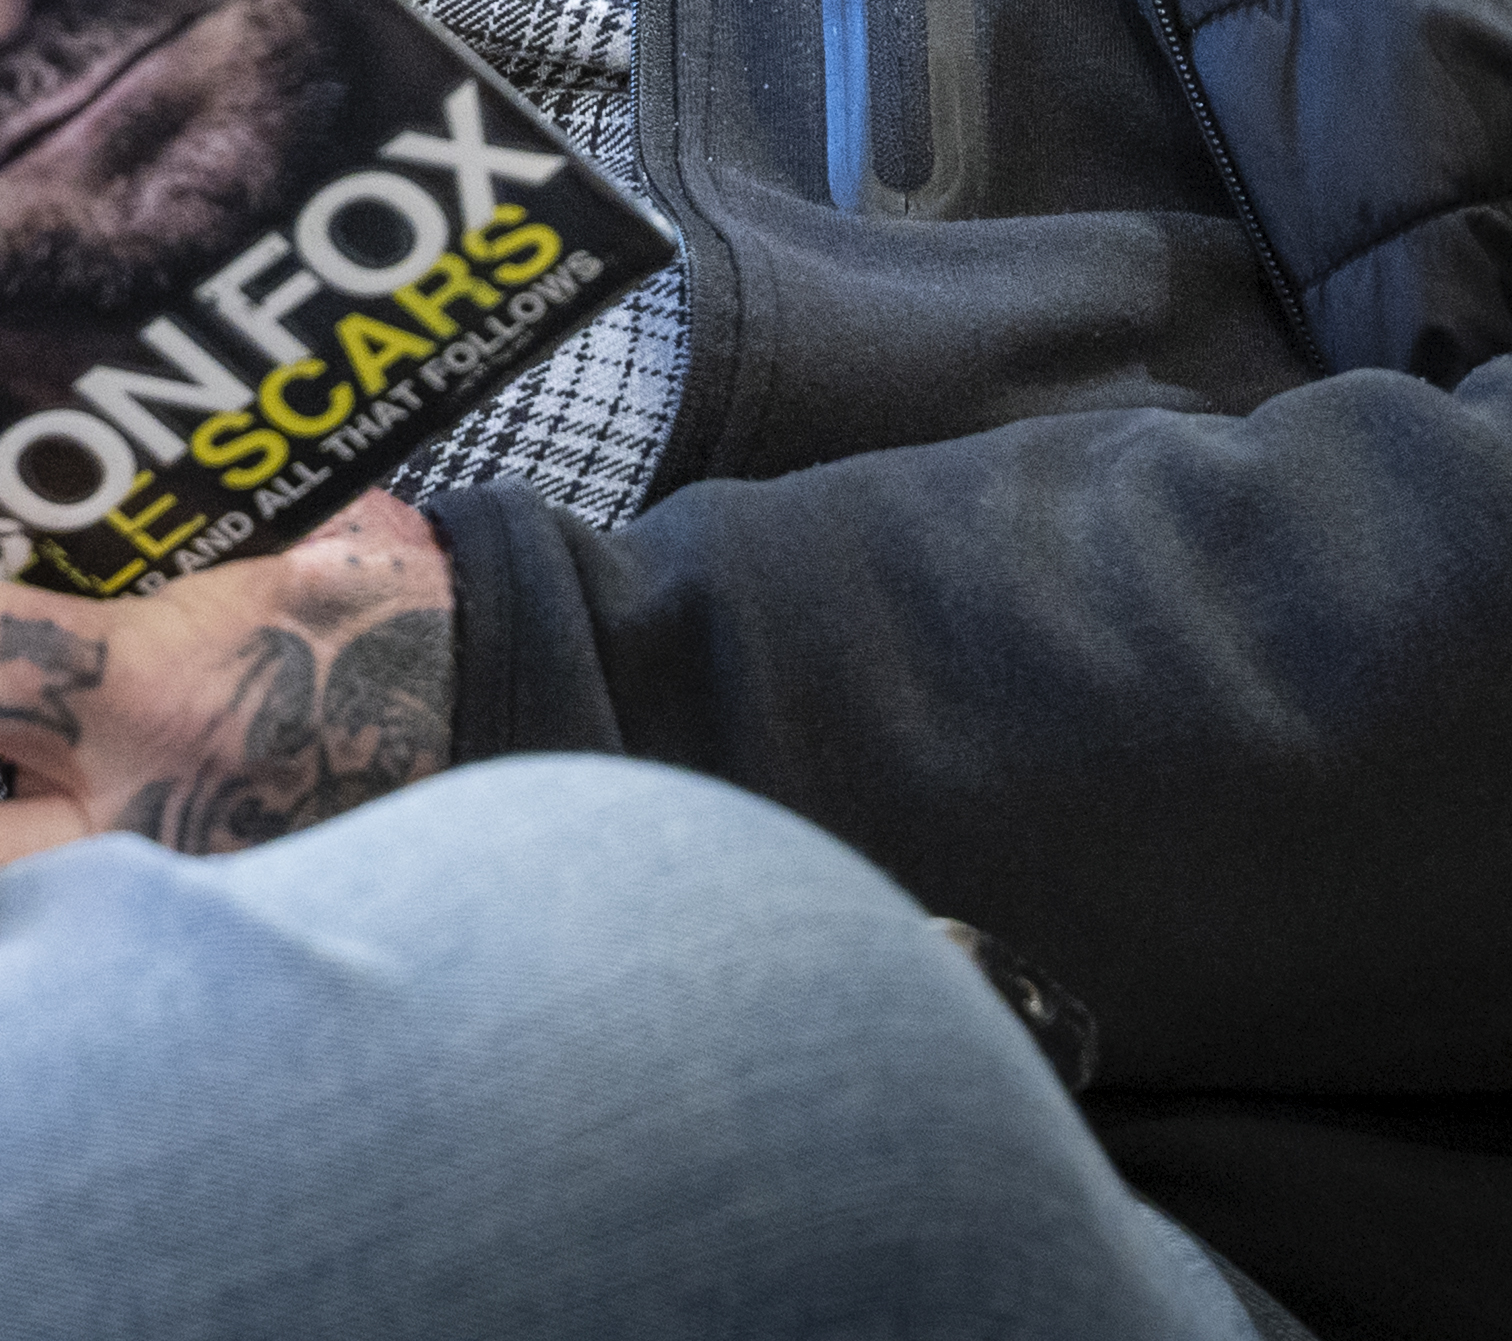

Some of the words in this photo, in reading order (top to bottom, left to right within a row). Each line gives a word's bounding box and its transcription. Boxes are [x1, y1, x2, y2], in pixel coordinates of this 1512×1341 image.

[189, 201, 564, 489] SCARS
[196, 79, 568, 365] FOX
[174, 510, 256, 577] AND
[251, 459, 335, 522] ALL
[320, 383, 423, 462] THAT
[418, 248, 605, 395] FOLLOWS
